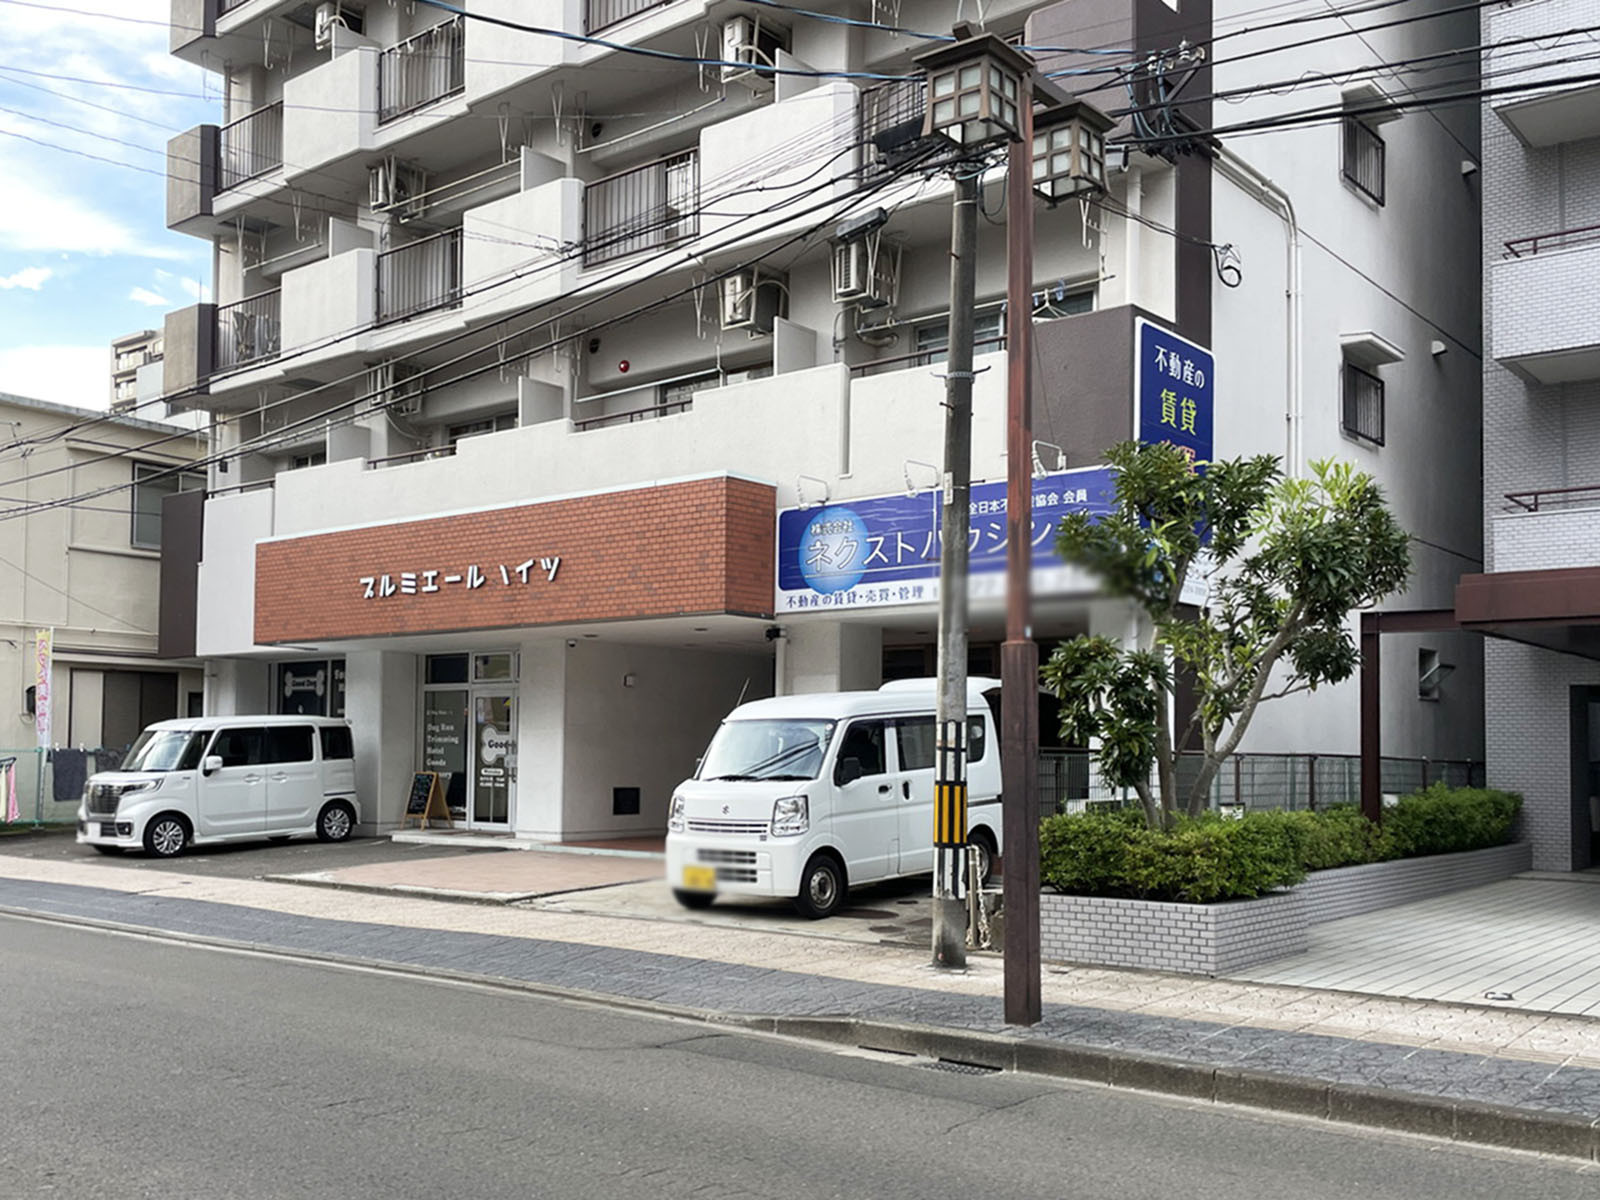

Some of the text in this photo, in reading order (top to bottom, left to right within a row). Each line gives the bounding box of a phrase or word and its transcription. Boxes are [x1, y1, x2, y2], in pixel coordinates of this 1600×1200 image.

[1154, 344, 1205, 389] 不動産の
[1160, 388, 1197, 436] 賃貸
[969, 488, 1088, 516] 全日本不協会 会員
[811, 519, 854, 536] 株式会社
